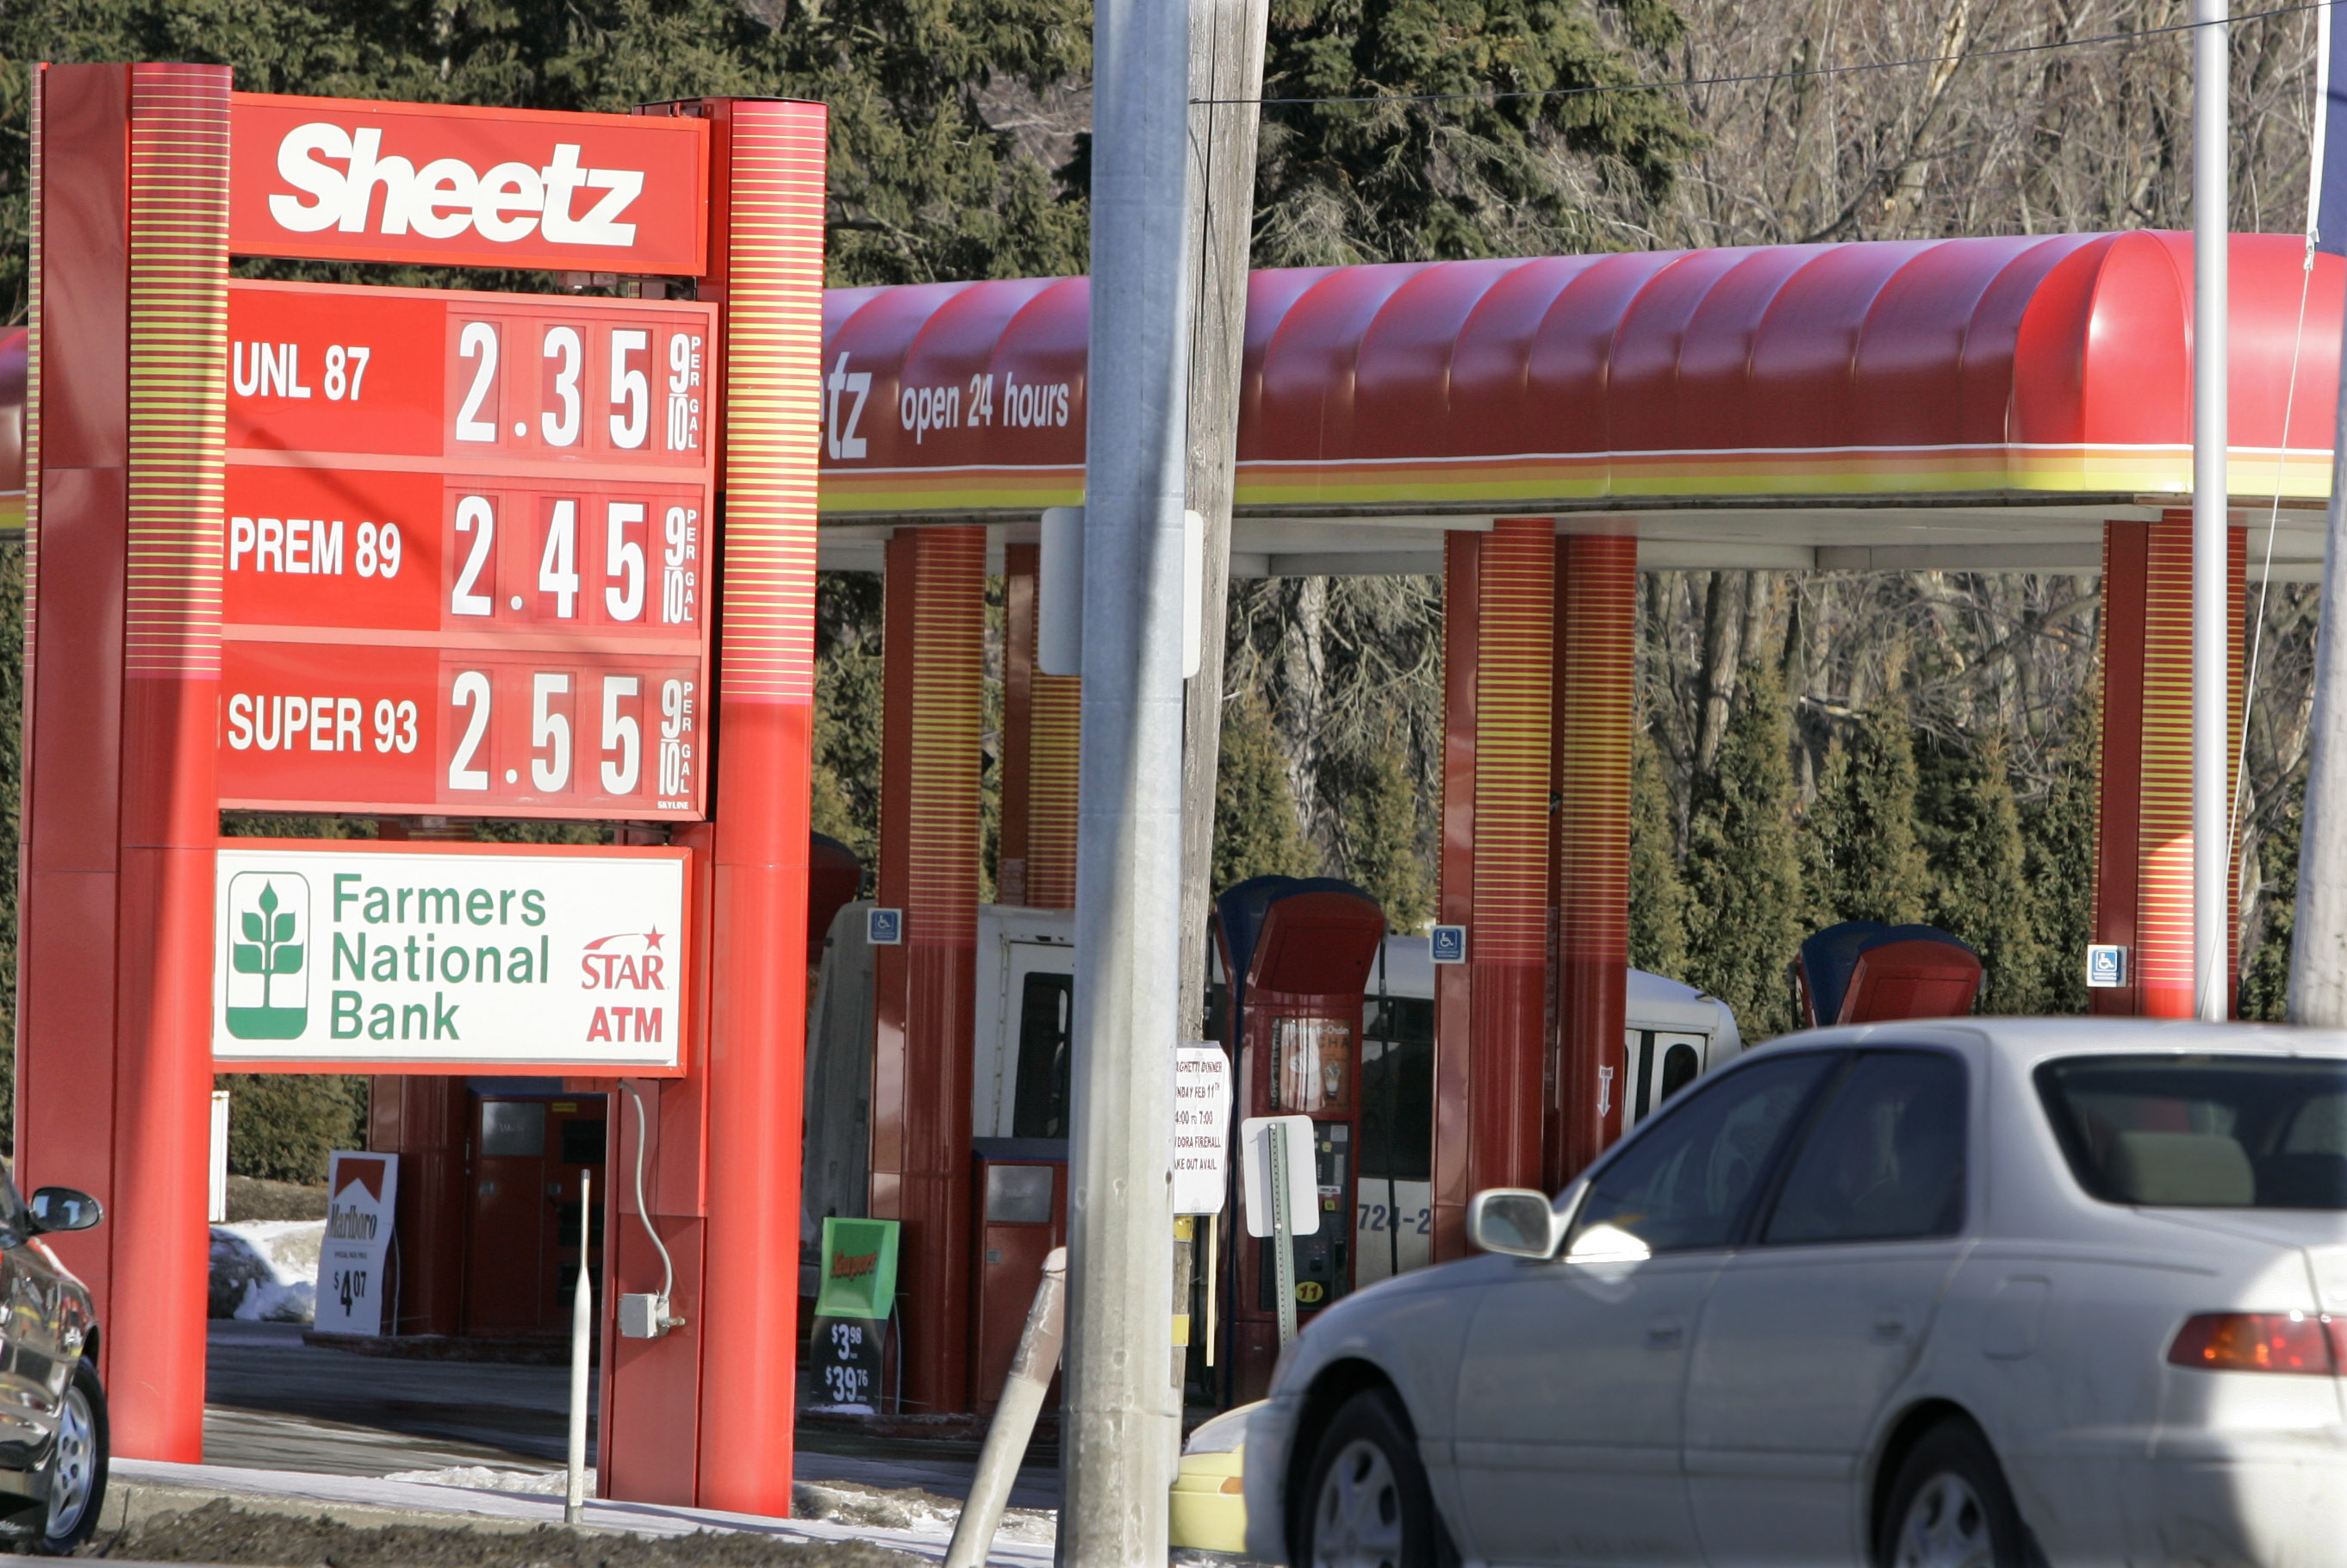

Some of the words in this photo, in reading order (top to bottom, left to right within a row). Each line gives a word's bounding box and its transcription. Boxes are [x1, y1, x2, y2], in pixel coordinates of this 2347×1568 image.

[268, 121, 644, 247] Sheetz
[233, 341, 311, 398] UNL
[324, 345, 370, 401] 87
[455, 321, 648, 449] 2.35
[690, 336, 701, 386] PER
[688, 399, 699, 448] GAL
[819, 352, 872, 460] tz
[901, 386, 960, 445] open
[968, 373, 993, 427] 24
[1003, 371, 1069, 428] hours
[229, 517, 344, 576] PREM
[355, 521, 402, 579] 89
[451, 495, 646, 621] 2.45
[686, 509, 697, 559] PER
[683, 572, 694, 621] GAL
[227, 693, 362, 752] SUPER
[374, 699, 418, 754] 93
[682, 681, 693, 731] PER
[448, 670, 639, 795] 2.55
[680, 744, 691, 793] GAL
[657, 800, 689, 810] SKYLINE
[333, 872, 546, 927] Farmers
[332, 931, 549, 984] National
[581, 953, 665, 991] STAR
[330, 989, 461, 1041] Bank
[586, 1005, 663, 1043] ATM
[1194, 1086, 1206, 1098] FEB
[1174, 1110, 1190, 1124] 4:00
[1198, 1110, 1213, 1125] 7:00
[1194, 1136, 1222, 1148] FIREHALL
[1186, 1158, 1198, 1170] OUT
[330, 1204, 378, 1241] Marlboro
[1298, 1283, 1323, 1301] 11
